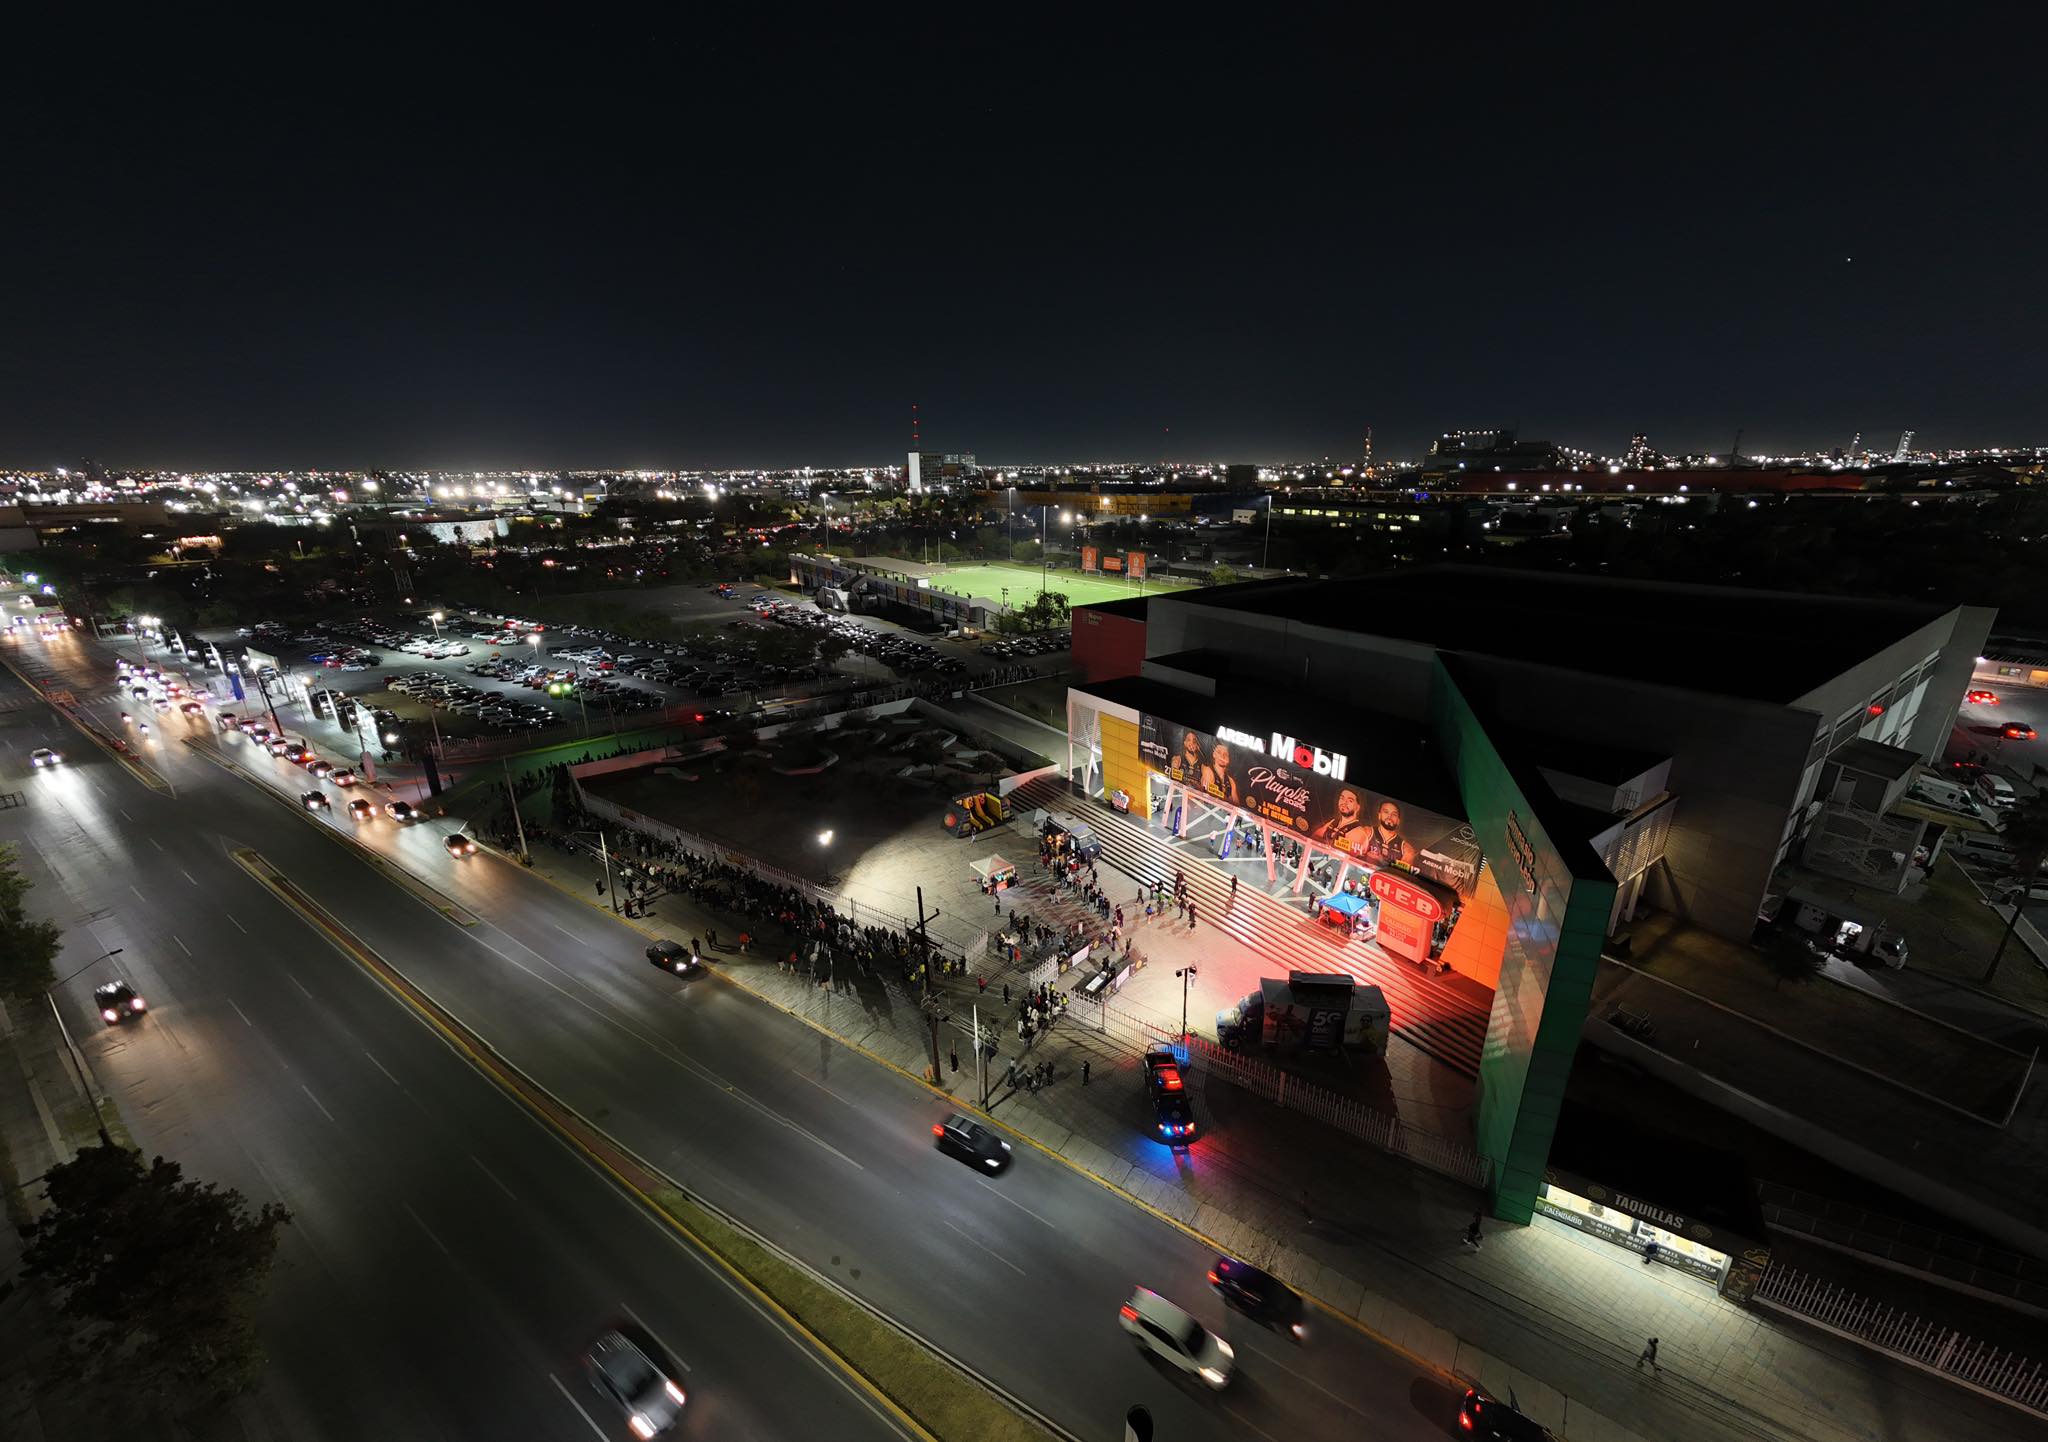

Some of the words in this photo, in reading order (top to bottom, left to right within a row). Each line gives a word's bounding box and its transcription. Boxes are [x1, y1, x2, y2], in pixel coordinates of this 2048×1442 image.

[1217, 726, 1265, 753] ARENA
[1271, 732, 1347, 781] Mobil
[1248, 766, 1310, 804] Playoffs
[1422, 859, 1442, 871] ARENA
[1443, 864, 1471, 880] Mobil
[1615, 1193, 1684, 1229] TAQUILLAS
